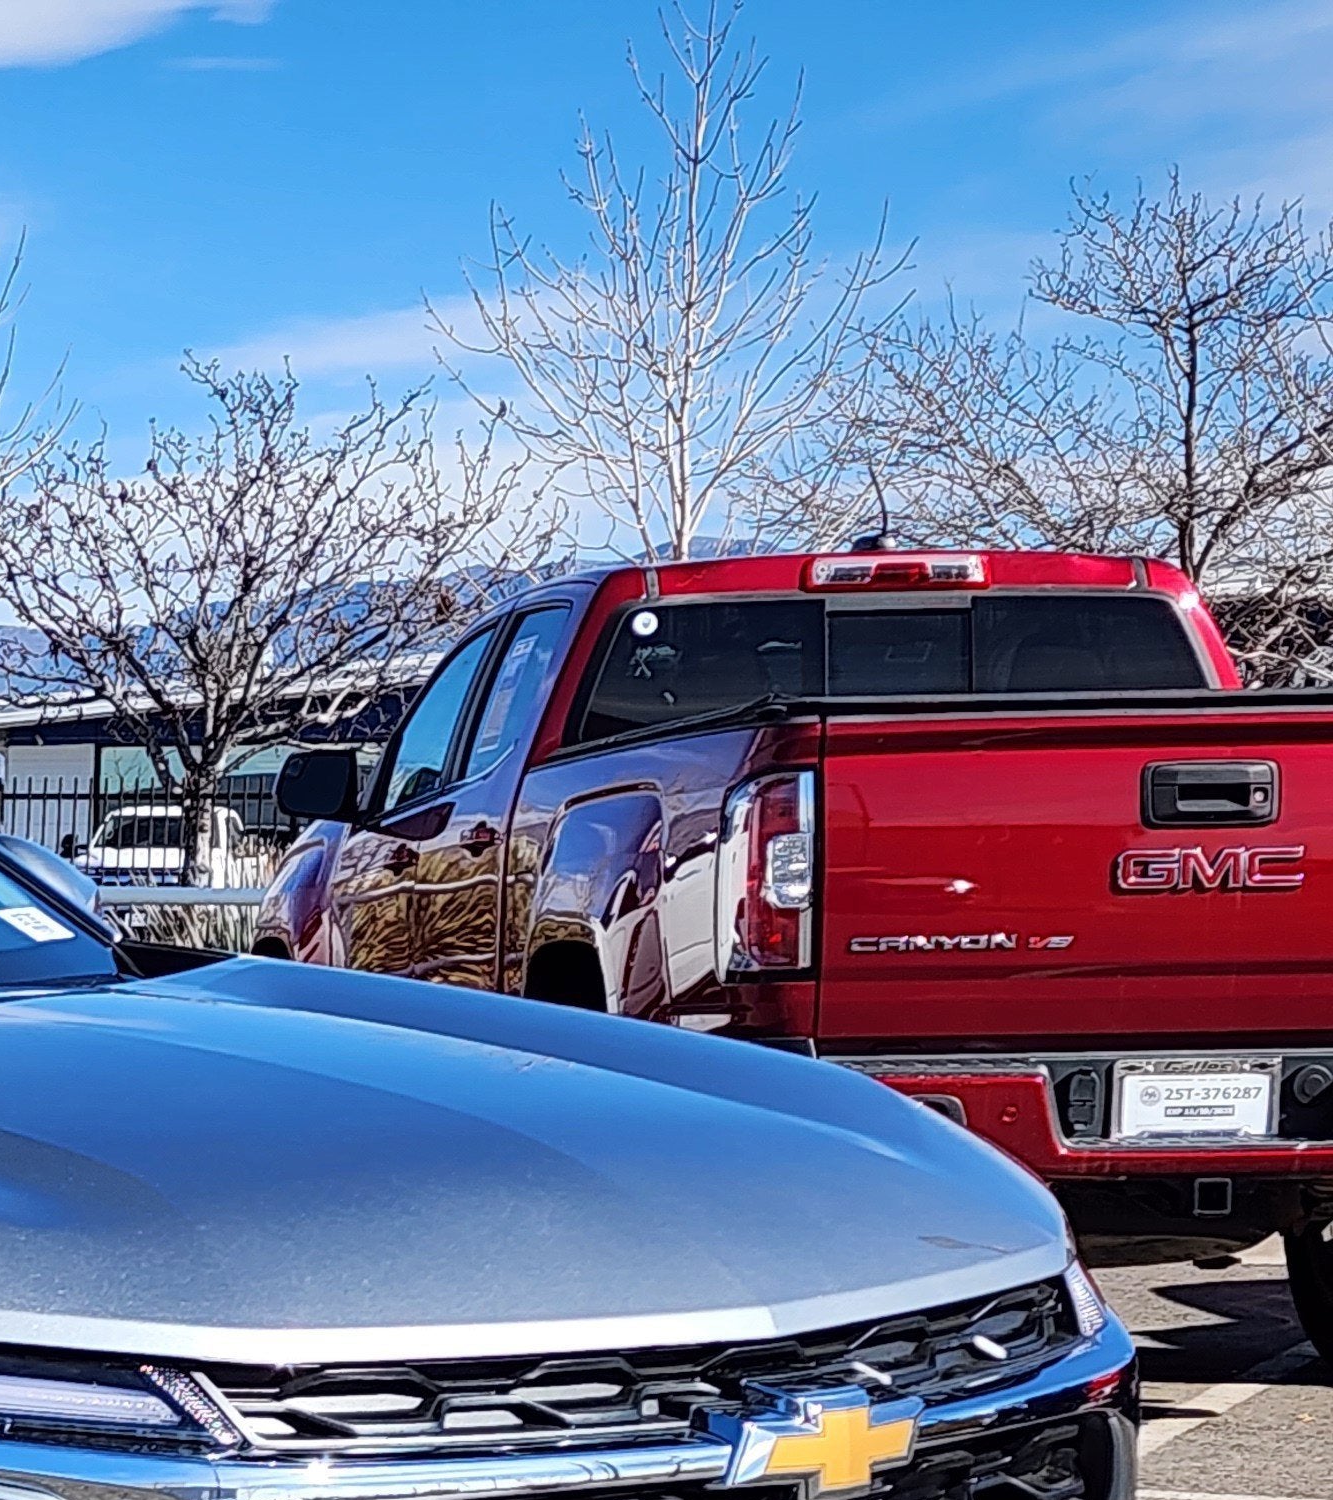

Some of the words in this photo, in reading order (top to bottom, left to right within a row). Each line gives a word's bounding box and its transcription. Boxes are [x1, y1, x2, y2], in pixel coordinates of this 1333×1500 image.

[1117, 845, 1305, 890] GMC
[850, 932, 1017, 952] CANYON
[1164, 1086, 1263, 1100] 25T-376287
